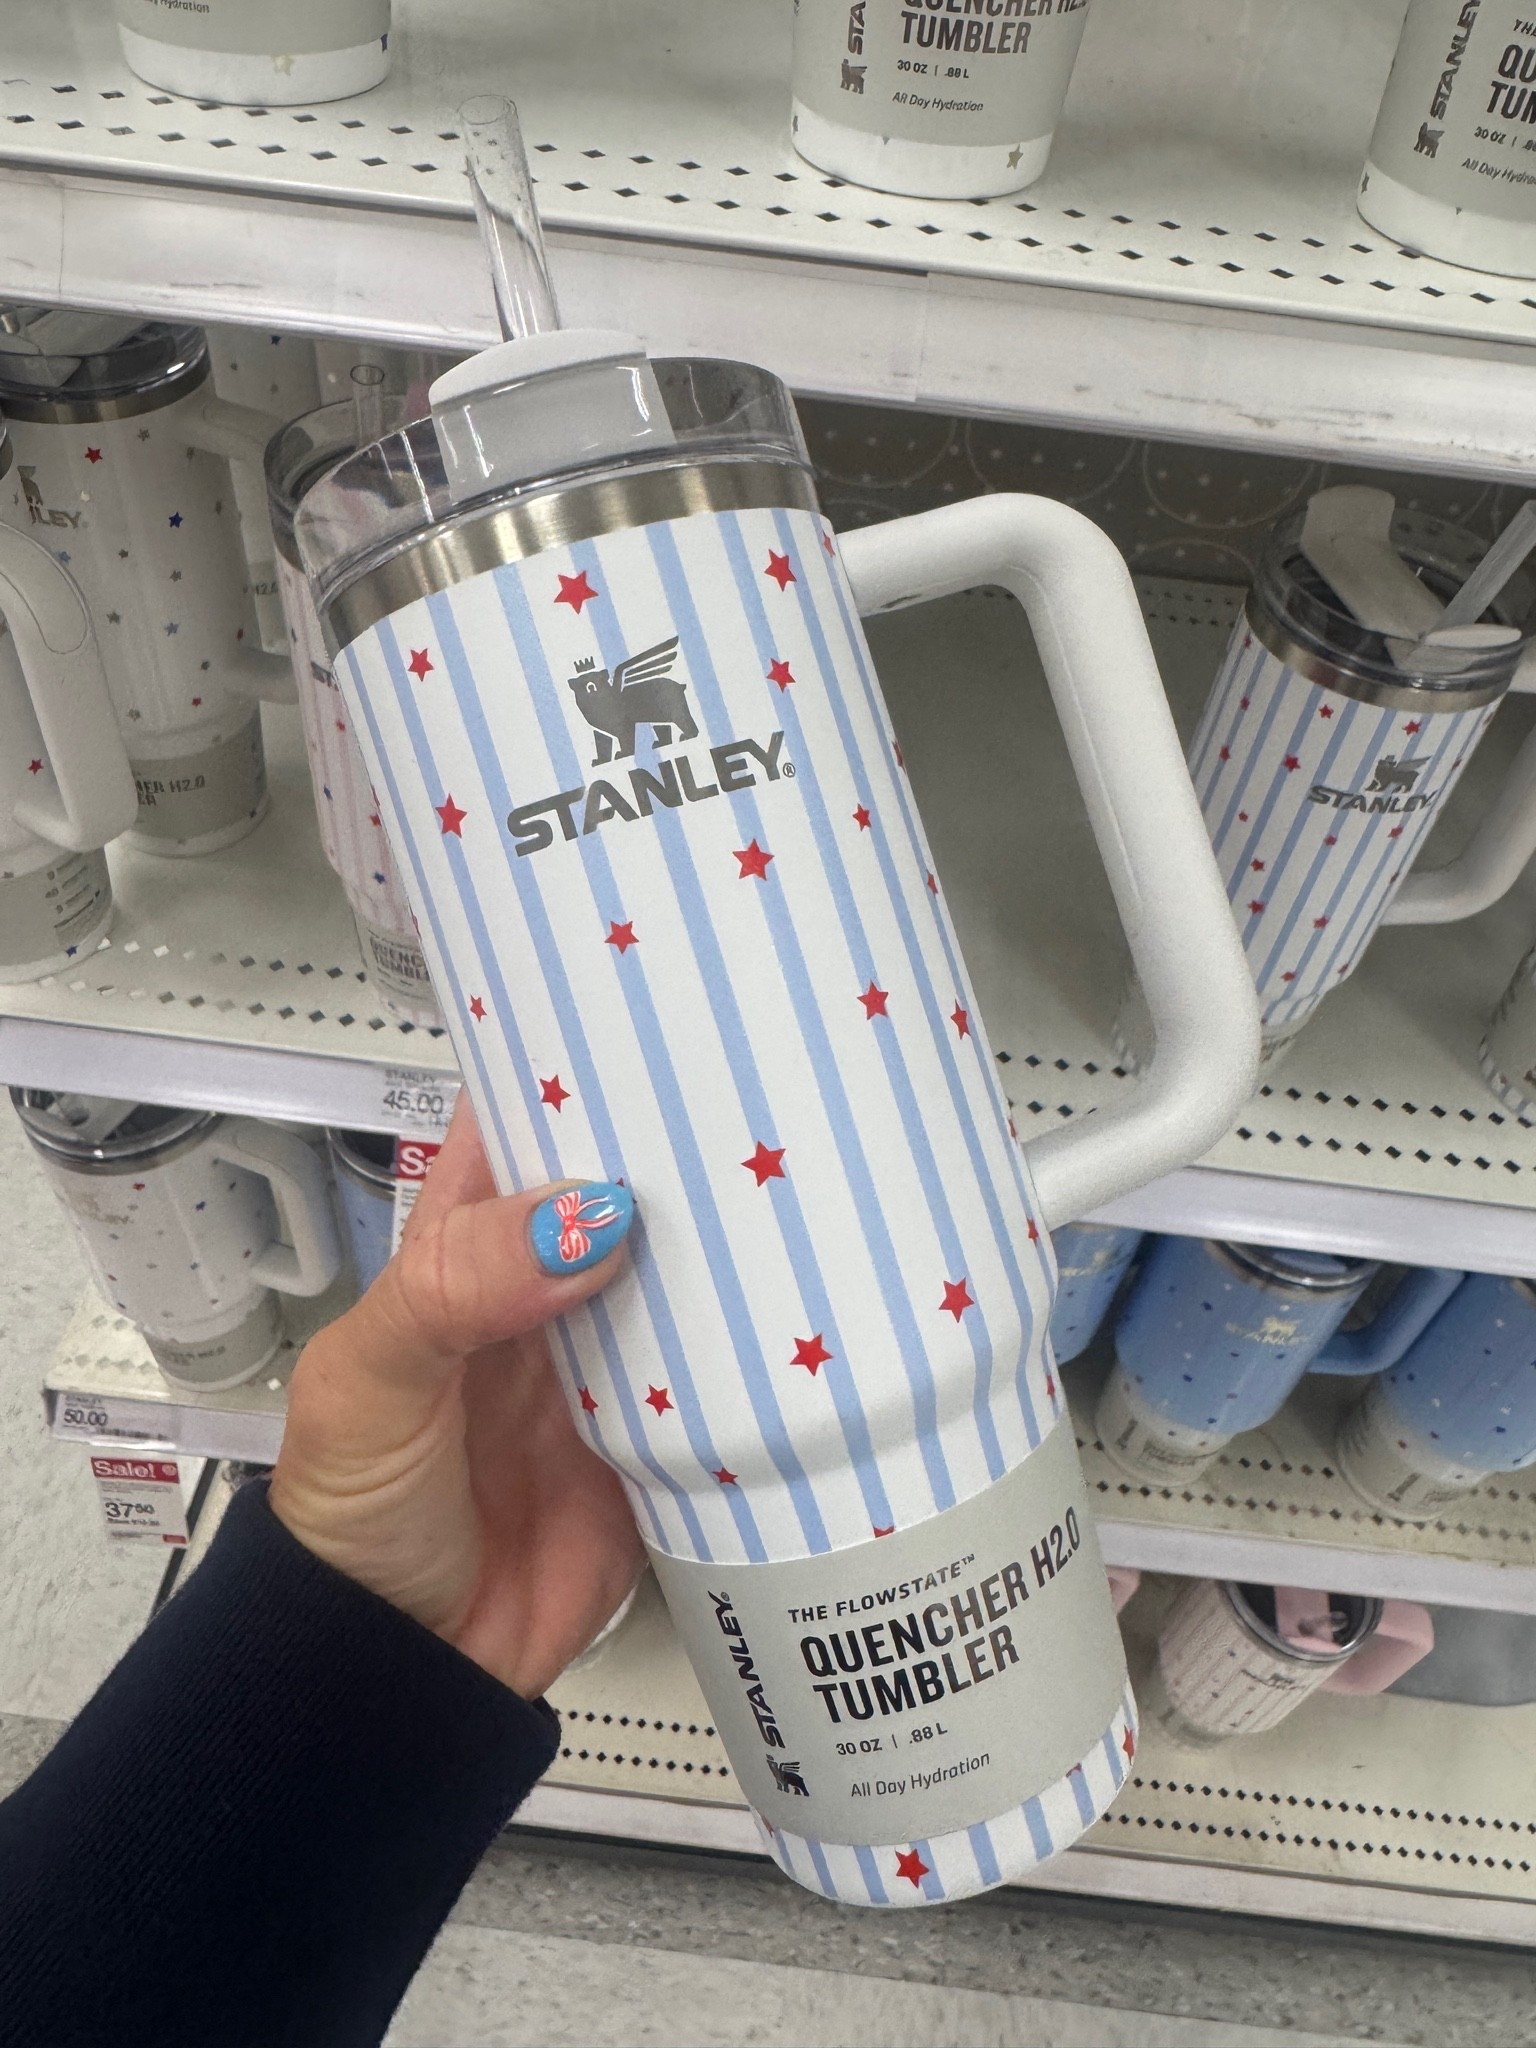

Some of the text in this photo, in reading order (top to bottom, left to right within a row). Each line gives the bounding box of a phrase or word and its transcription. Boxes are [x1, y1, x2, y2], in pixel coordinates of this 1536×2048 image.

[900, 10, 1032, 54] TUMBLER
[897, 59, 911, 73] 30
[913, 62, 928, 74] OZ
[909, 94, 930, 109] Day
[932, 98, 984, 112] Hydration
[1479, 162, 1501, 180] Day
[383, 1090, 444, 1114] 45.00
[64, 1408, 108, 1426] 50.00
[94, 1460, 156, 1479] Sale!
[800, 1506, 1081, 1678] QUENCHER H2.0
[788, 1605, 828, 1624] THE
[812, 1624, 1021, 1724] TUMBLER
[835, 1742, 857, 1756] 30
[859, 1738, 883, 1753] OZ
[909, 1726, 934, 1744] .88
[935, 1722, 948, 1735] L
[851, 1753, 990, 1797] All Day Hydration
